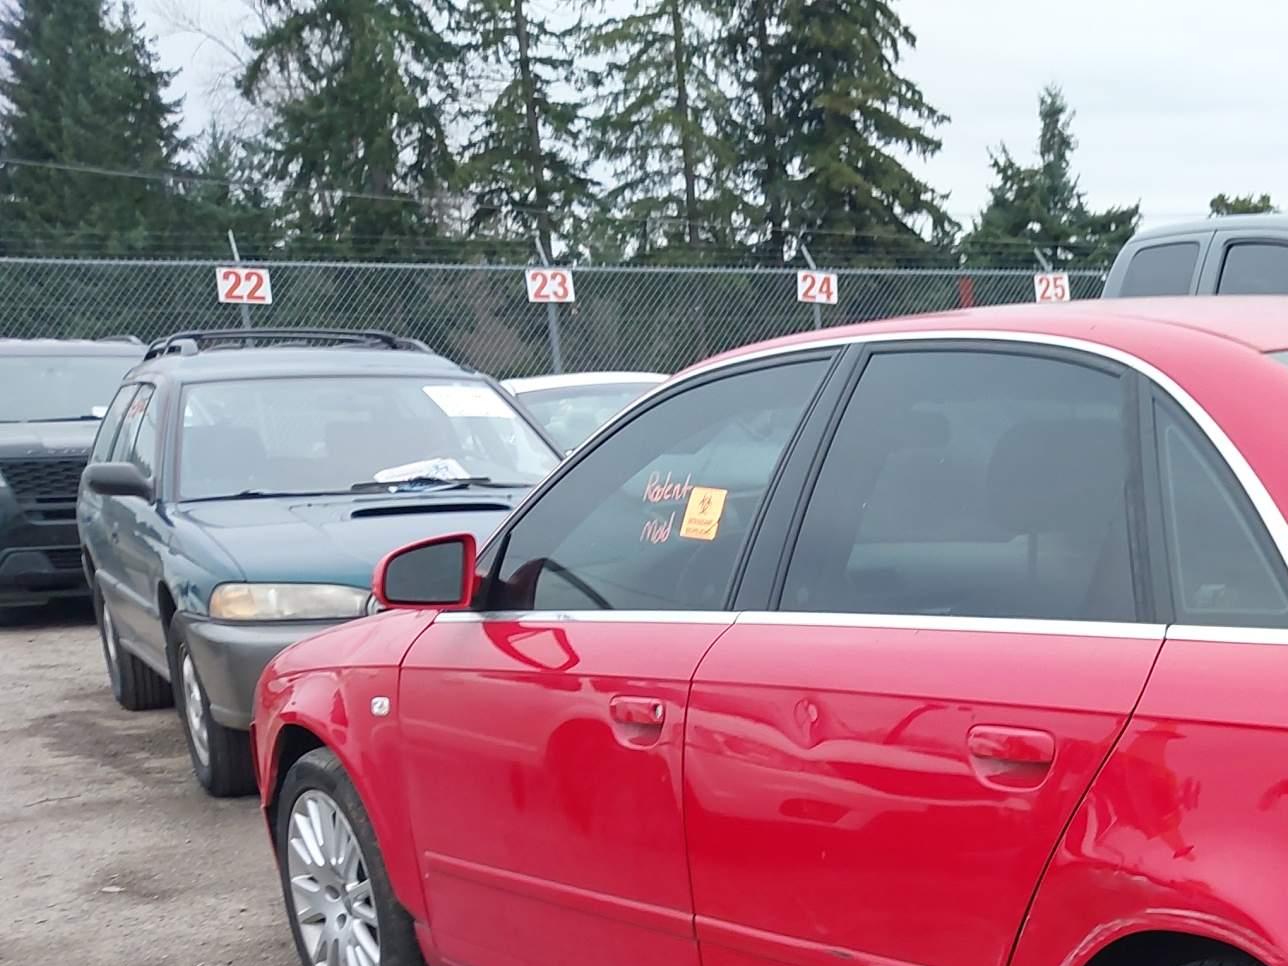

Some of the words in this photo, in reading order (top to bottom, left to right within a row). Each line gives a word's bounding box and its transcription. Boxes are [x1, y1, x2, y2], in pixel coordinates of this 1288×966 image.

[222, 270, 266, 301] 22
[530, 271, 570, 300] 23
[801, 273, 834, 301] 24
[1038, 276, 1066, 301] 25
[642, 471, 693, 503] Rodent
